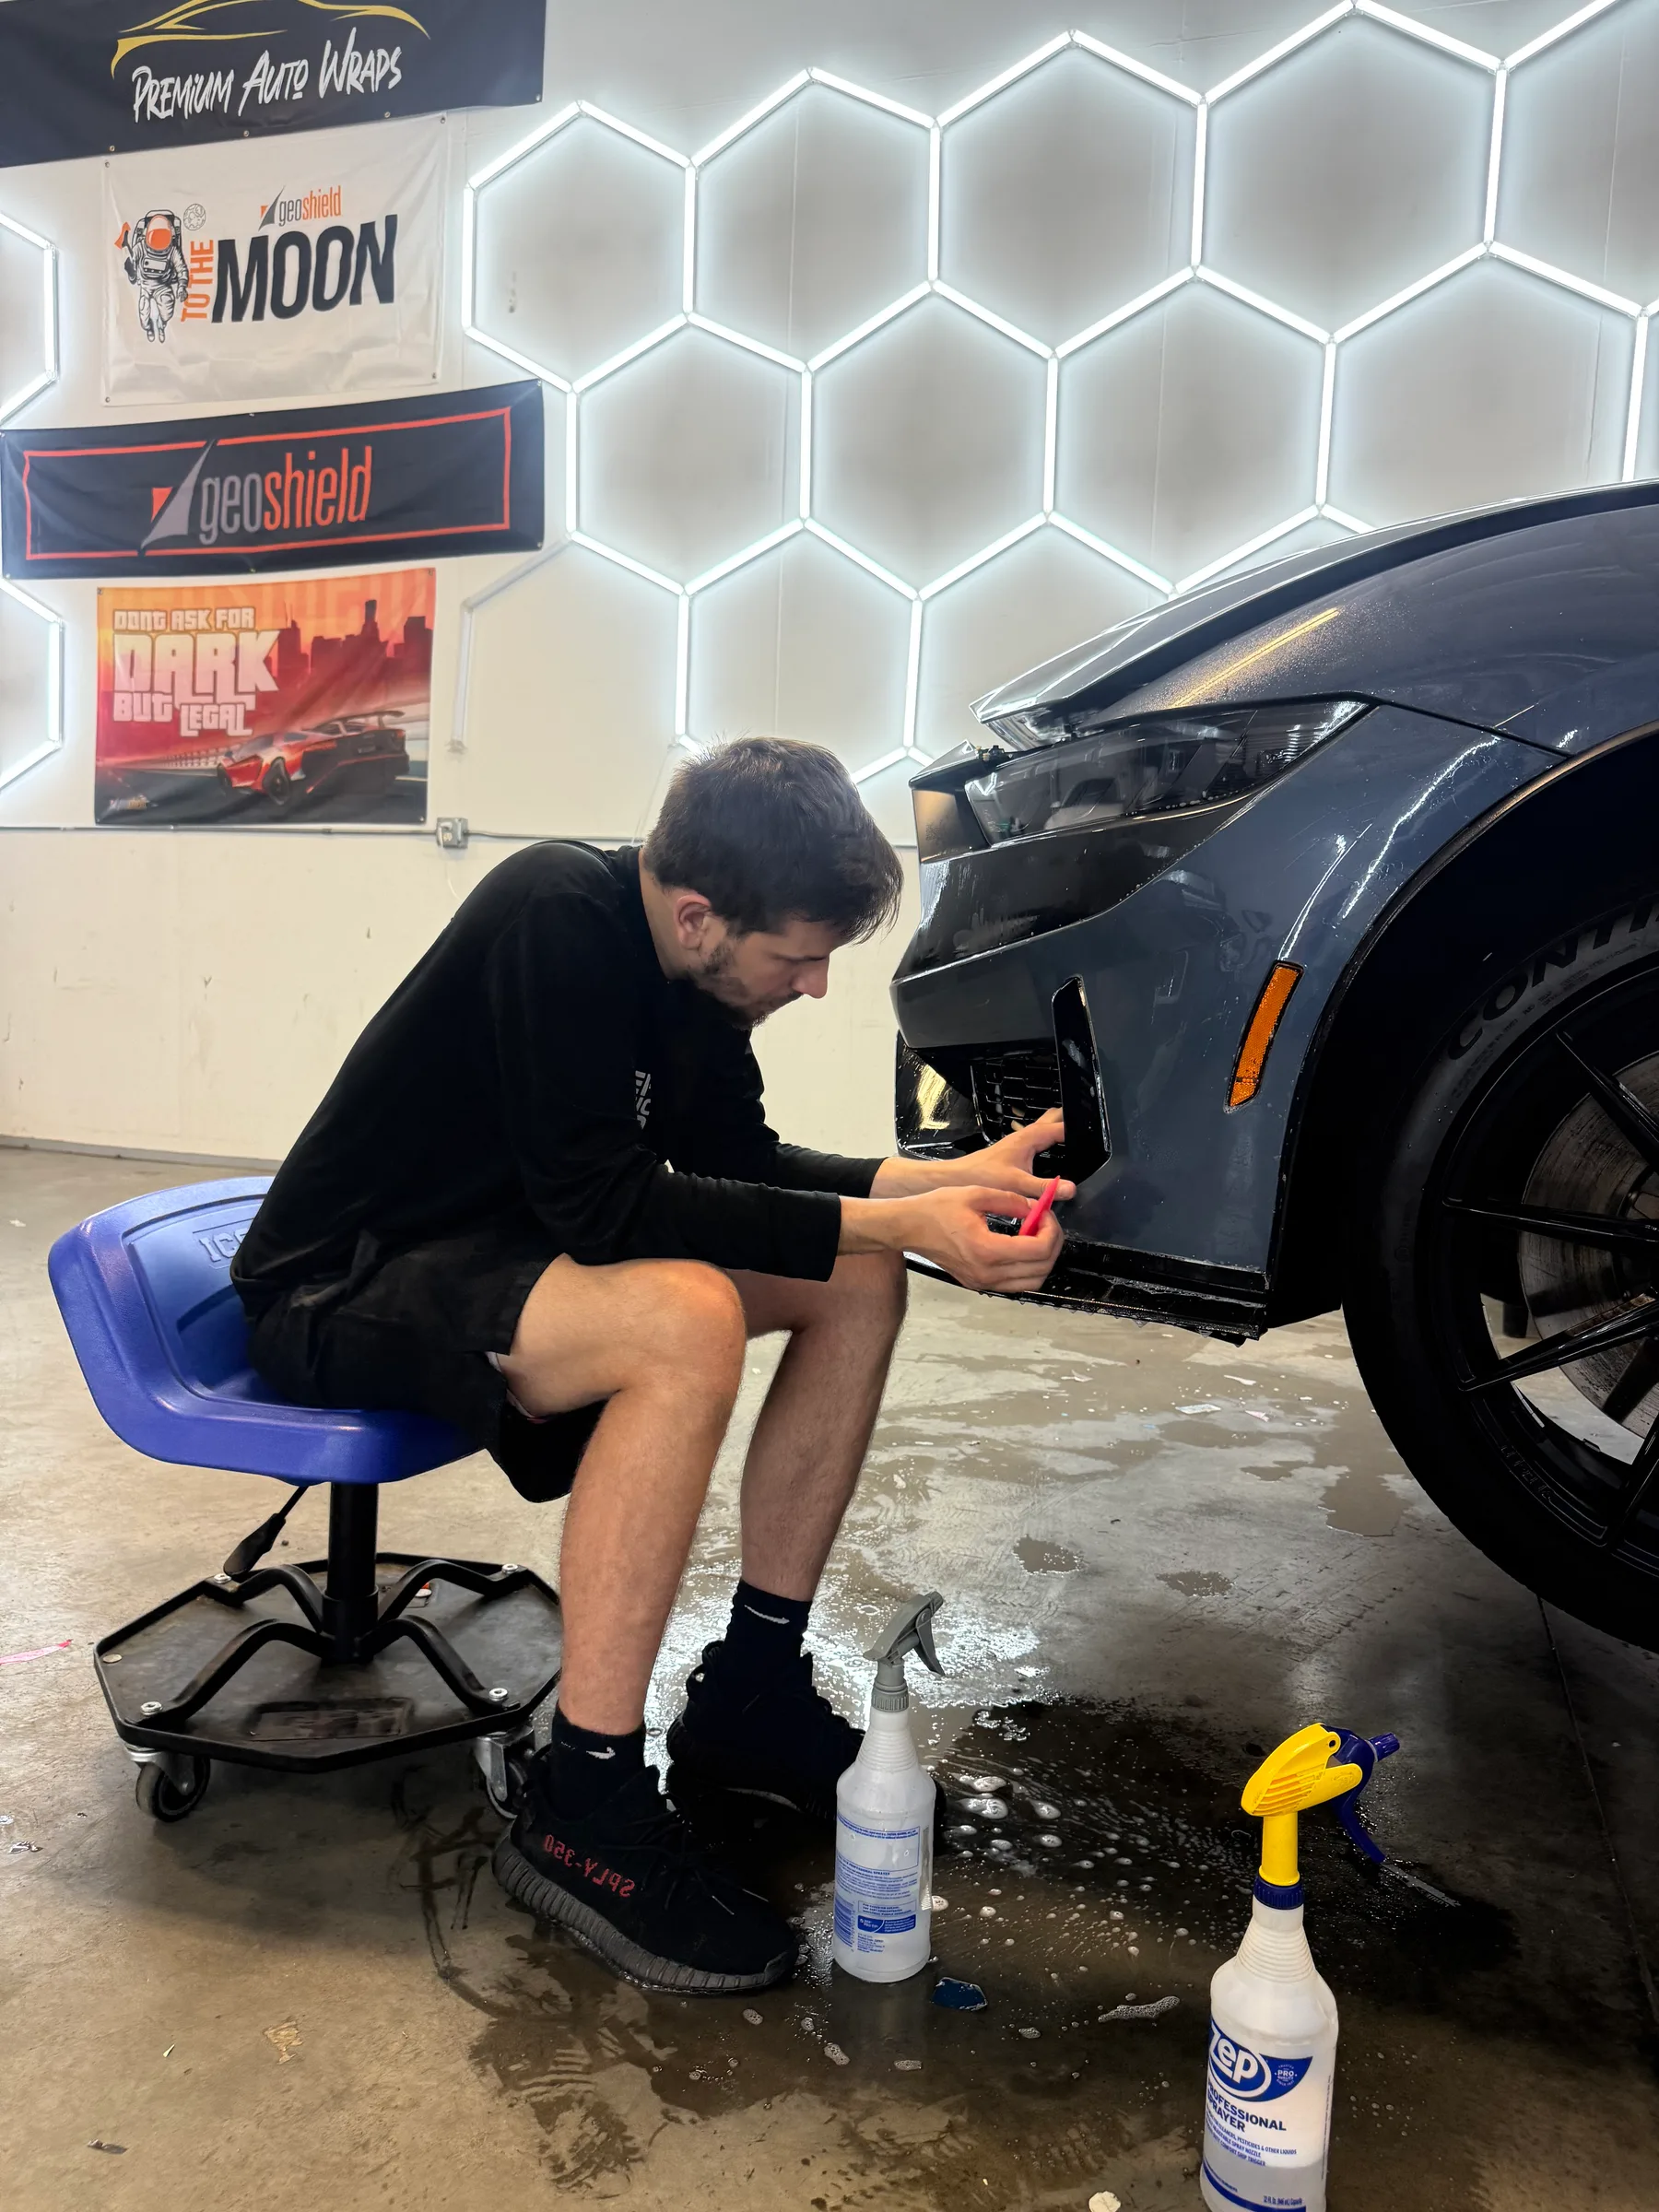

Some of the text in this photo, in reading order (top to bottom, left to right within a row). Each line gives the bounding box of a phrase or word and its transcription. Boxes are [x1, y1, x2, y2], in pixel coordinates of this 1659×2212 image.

[319, 27, 402, 99] WRAPS
[278, 185, 342, 227] geoshield
[181, 239, 214, 323] TO THE
[211, 214, 398, 323] MOON
[198, 445, 372, 545] geoshield
[171, 608, 212, 630] ASK
[216, 606, 255, 629] FOR
[113, 630, 280, 711] DARK
[113, 692, 172, 722] BUT
[180, 703, 253, 736] LEGAL
[1447, 898, 1659, 1060] CONTI
[1277, 2069, 1295, 2077] PRO
[1265, 2146, 1279, 2154] OTHER
